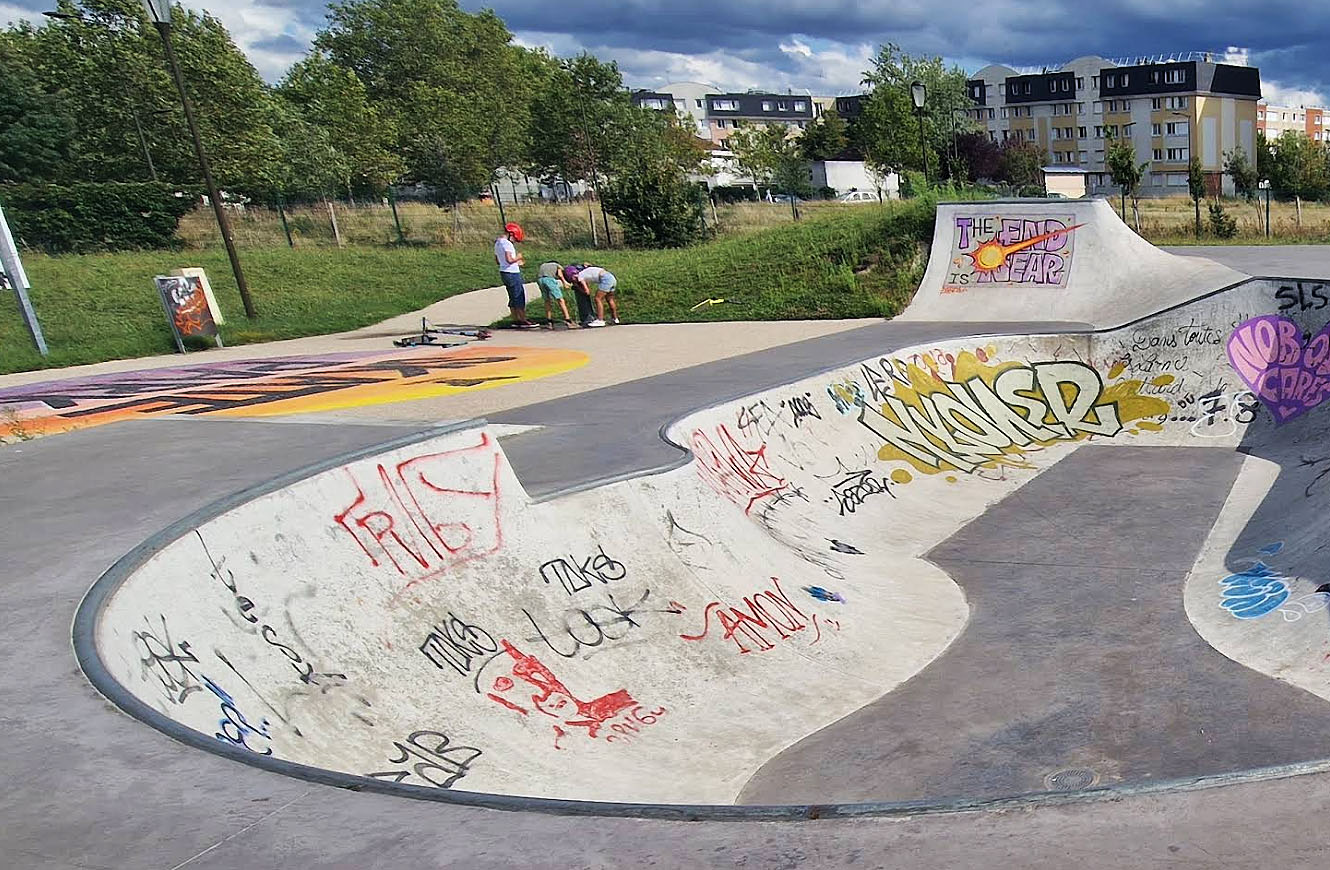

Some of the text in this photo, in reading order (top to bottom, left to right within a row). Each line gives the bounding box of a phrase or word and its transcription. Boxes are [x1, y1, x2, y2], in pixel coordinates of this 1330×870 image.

[956, 217, 1068, 253] THE END
[947, 273, 969, 285] IS
